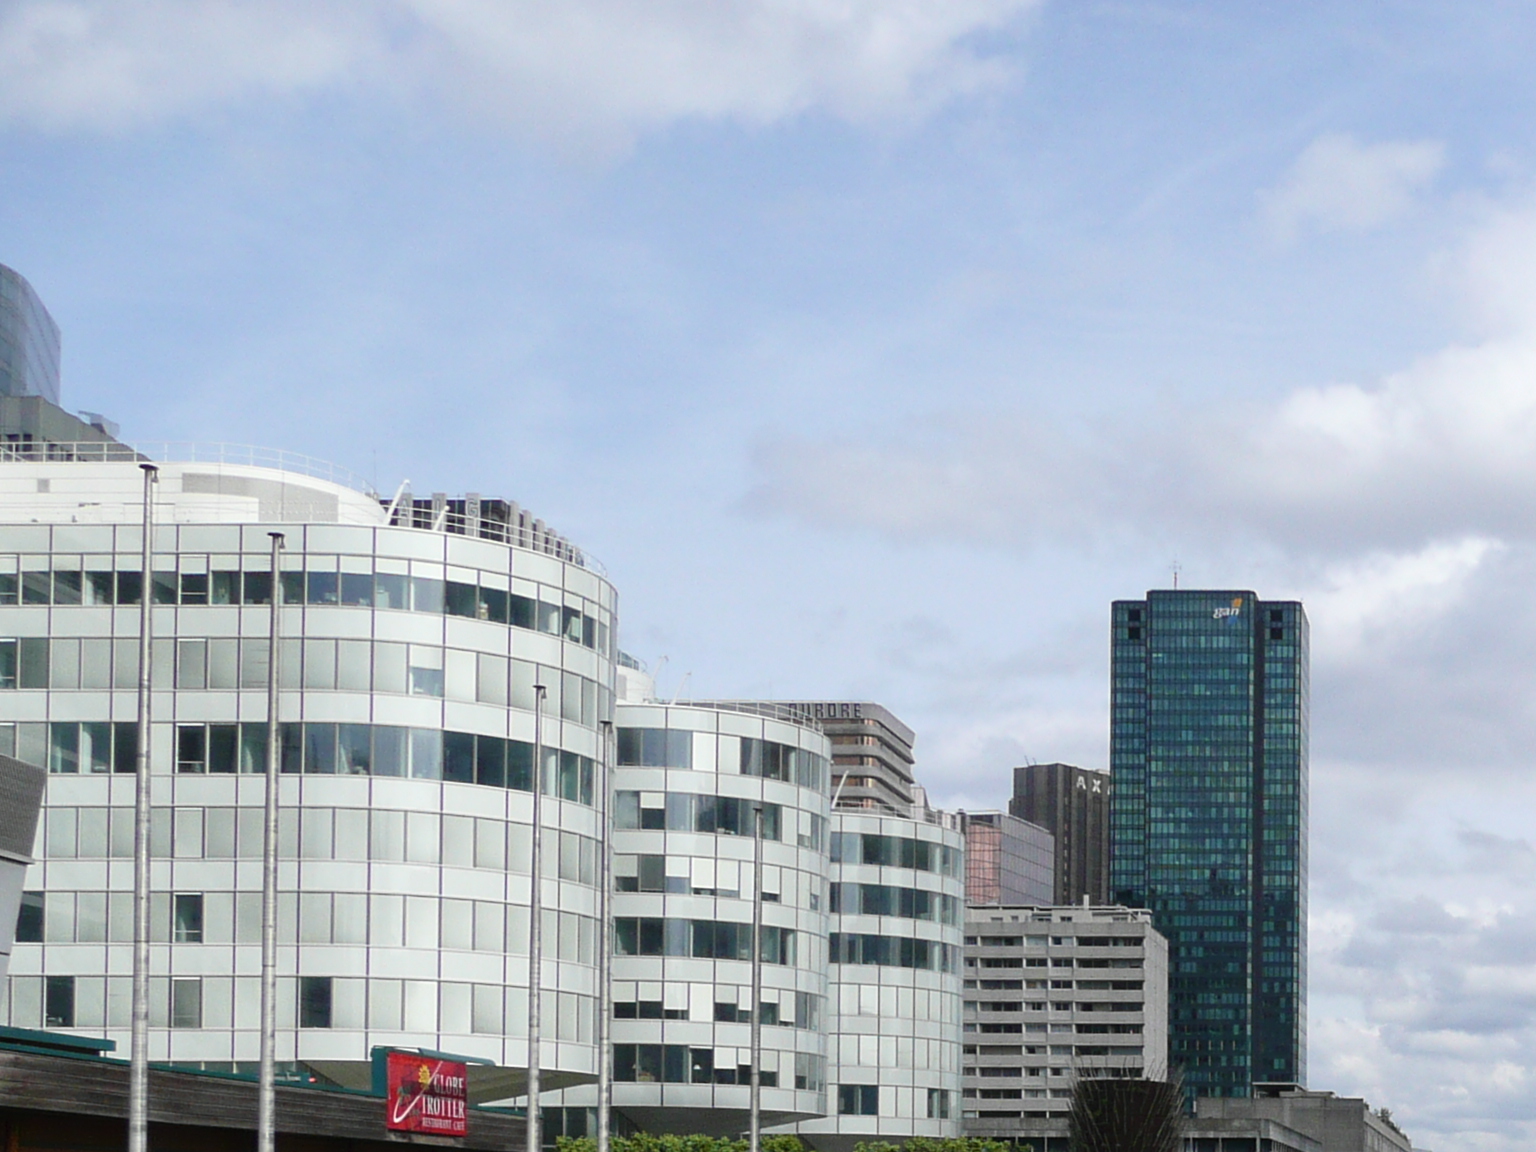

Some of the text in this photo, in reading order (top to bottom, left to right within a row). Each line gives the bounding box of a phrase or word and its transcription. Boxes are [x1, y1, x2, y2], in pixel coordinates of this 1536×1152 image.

[1213, 607, 1240, 619] gan
[788, 703, 862, 718] AURORE
[433, 1073, 465, 1097] GLOBE
[422, 1094, 465, 1119] TROTTER
